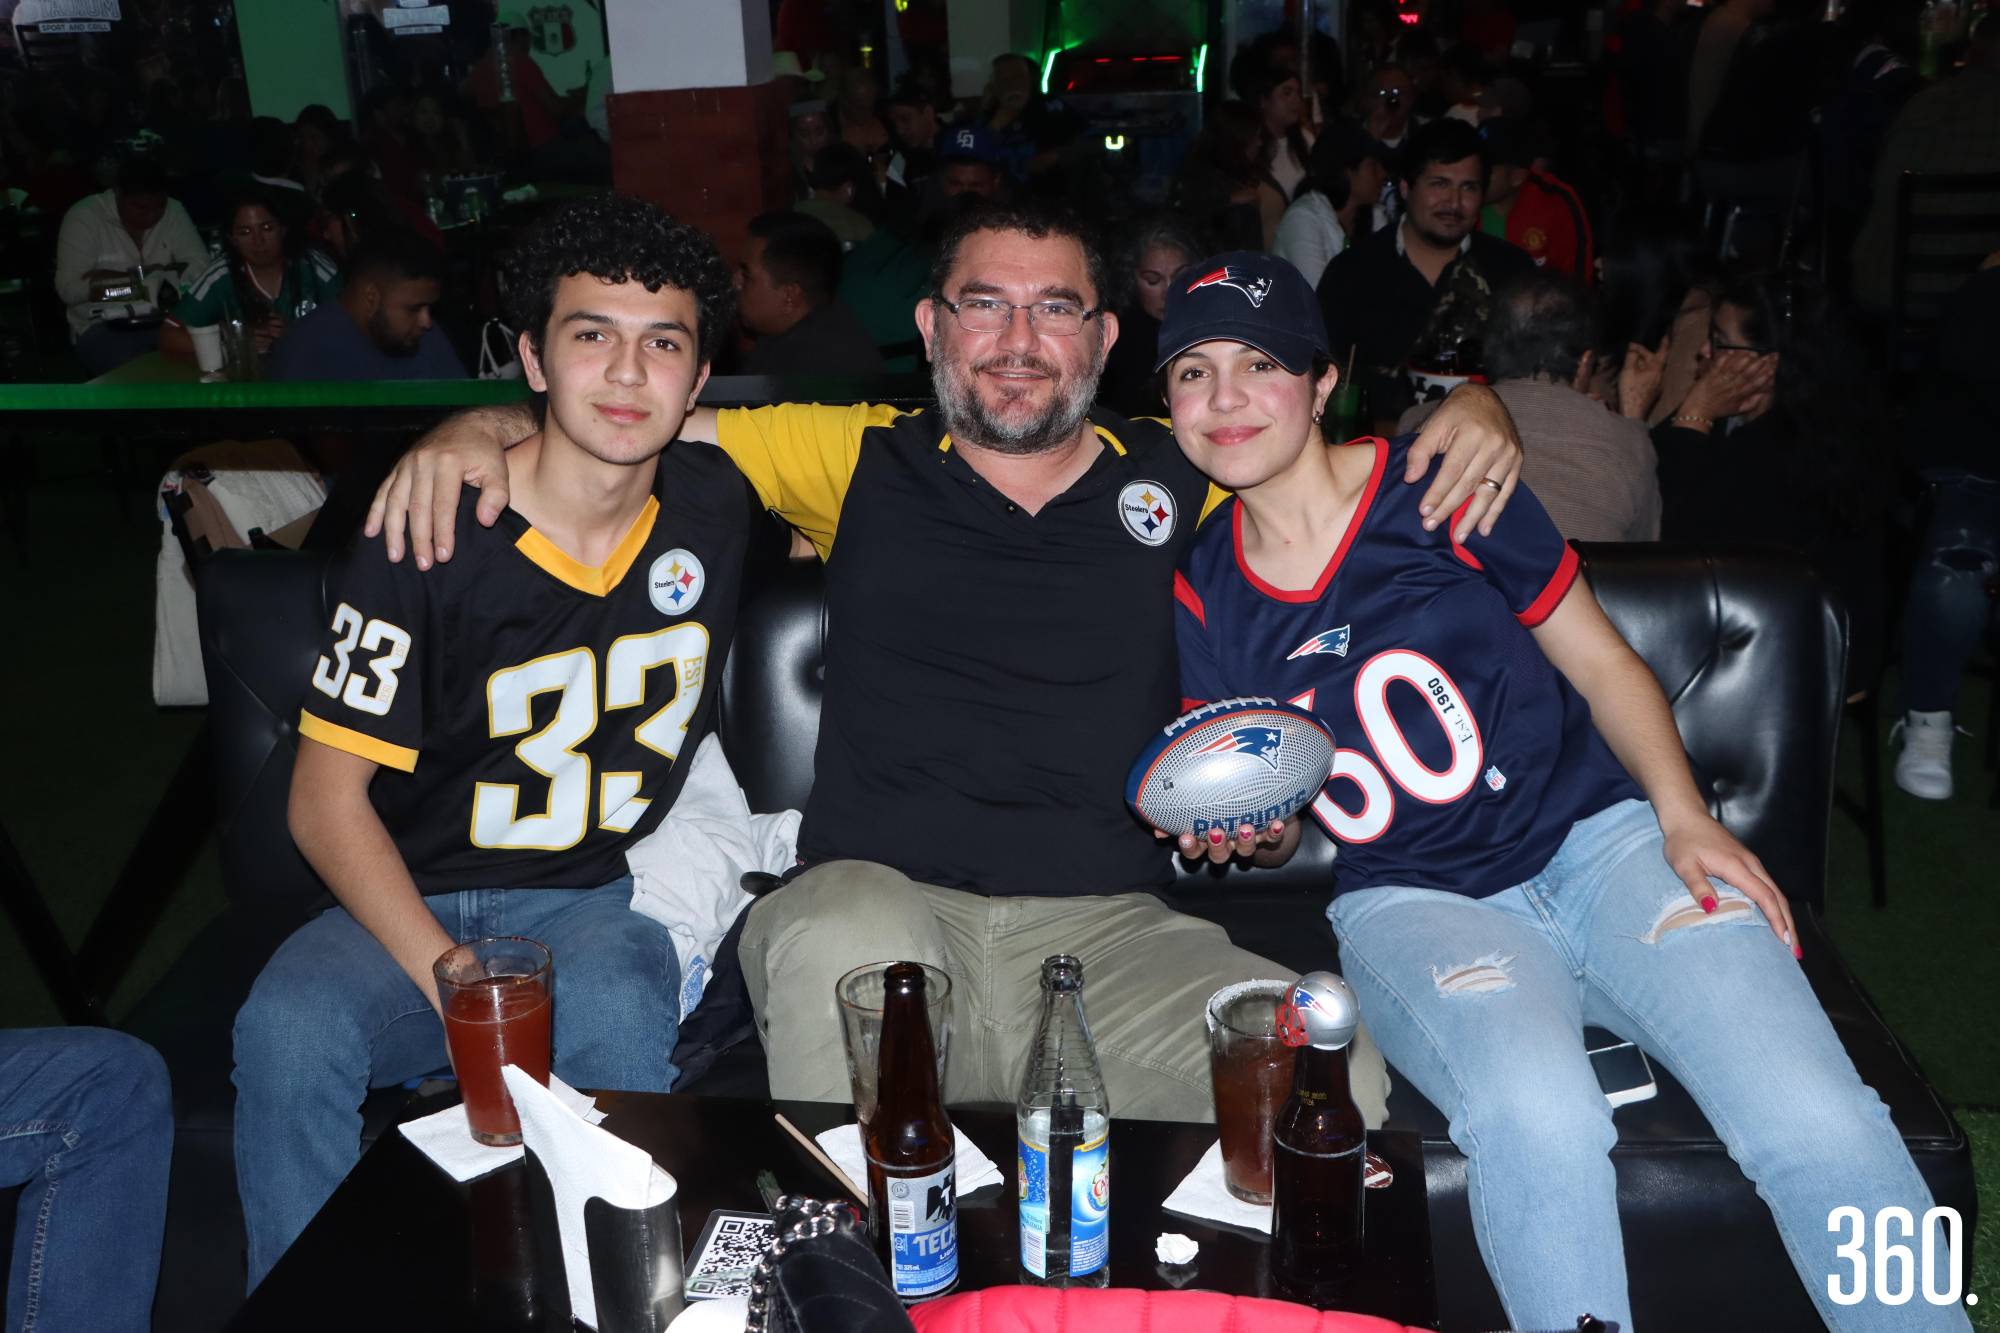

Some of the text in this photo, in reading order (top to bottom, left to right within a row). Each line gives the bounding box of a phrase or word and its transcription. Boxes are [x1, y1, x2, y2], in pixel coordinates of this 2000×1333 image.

[1124, 504, 1148, 514] Steelers
[654, 580, 675, 589] Steelers
[312, 602, 412, 716] 33
[1427, 677, 1455, 714] 1960
[469, 621, 710, 851] 33
